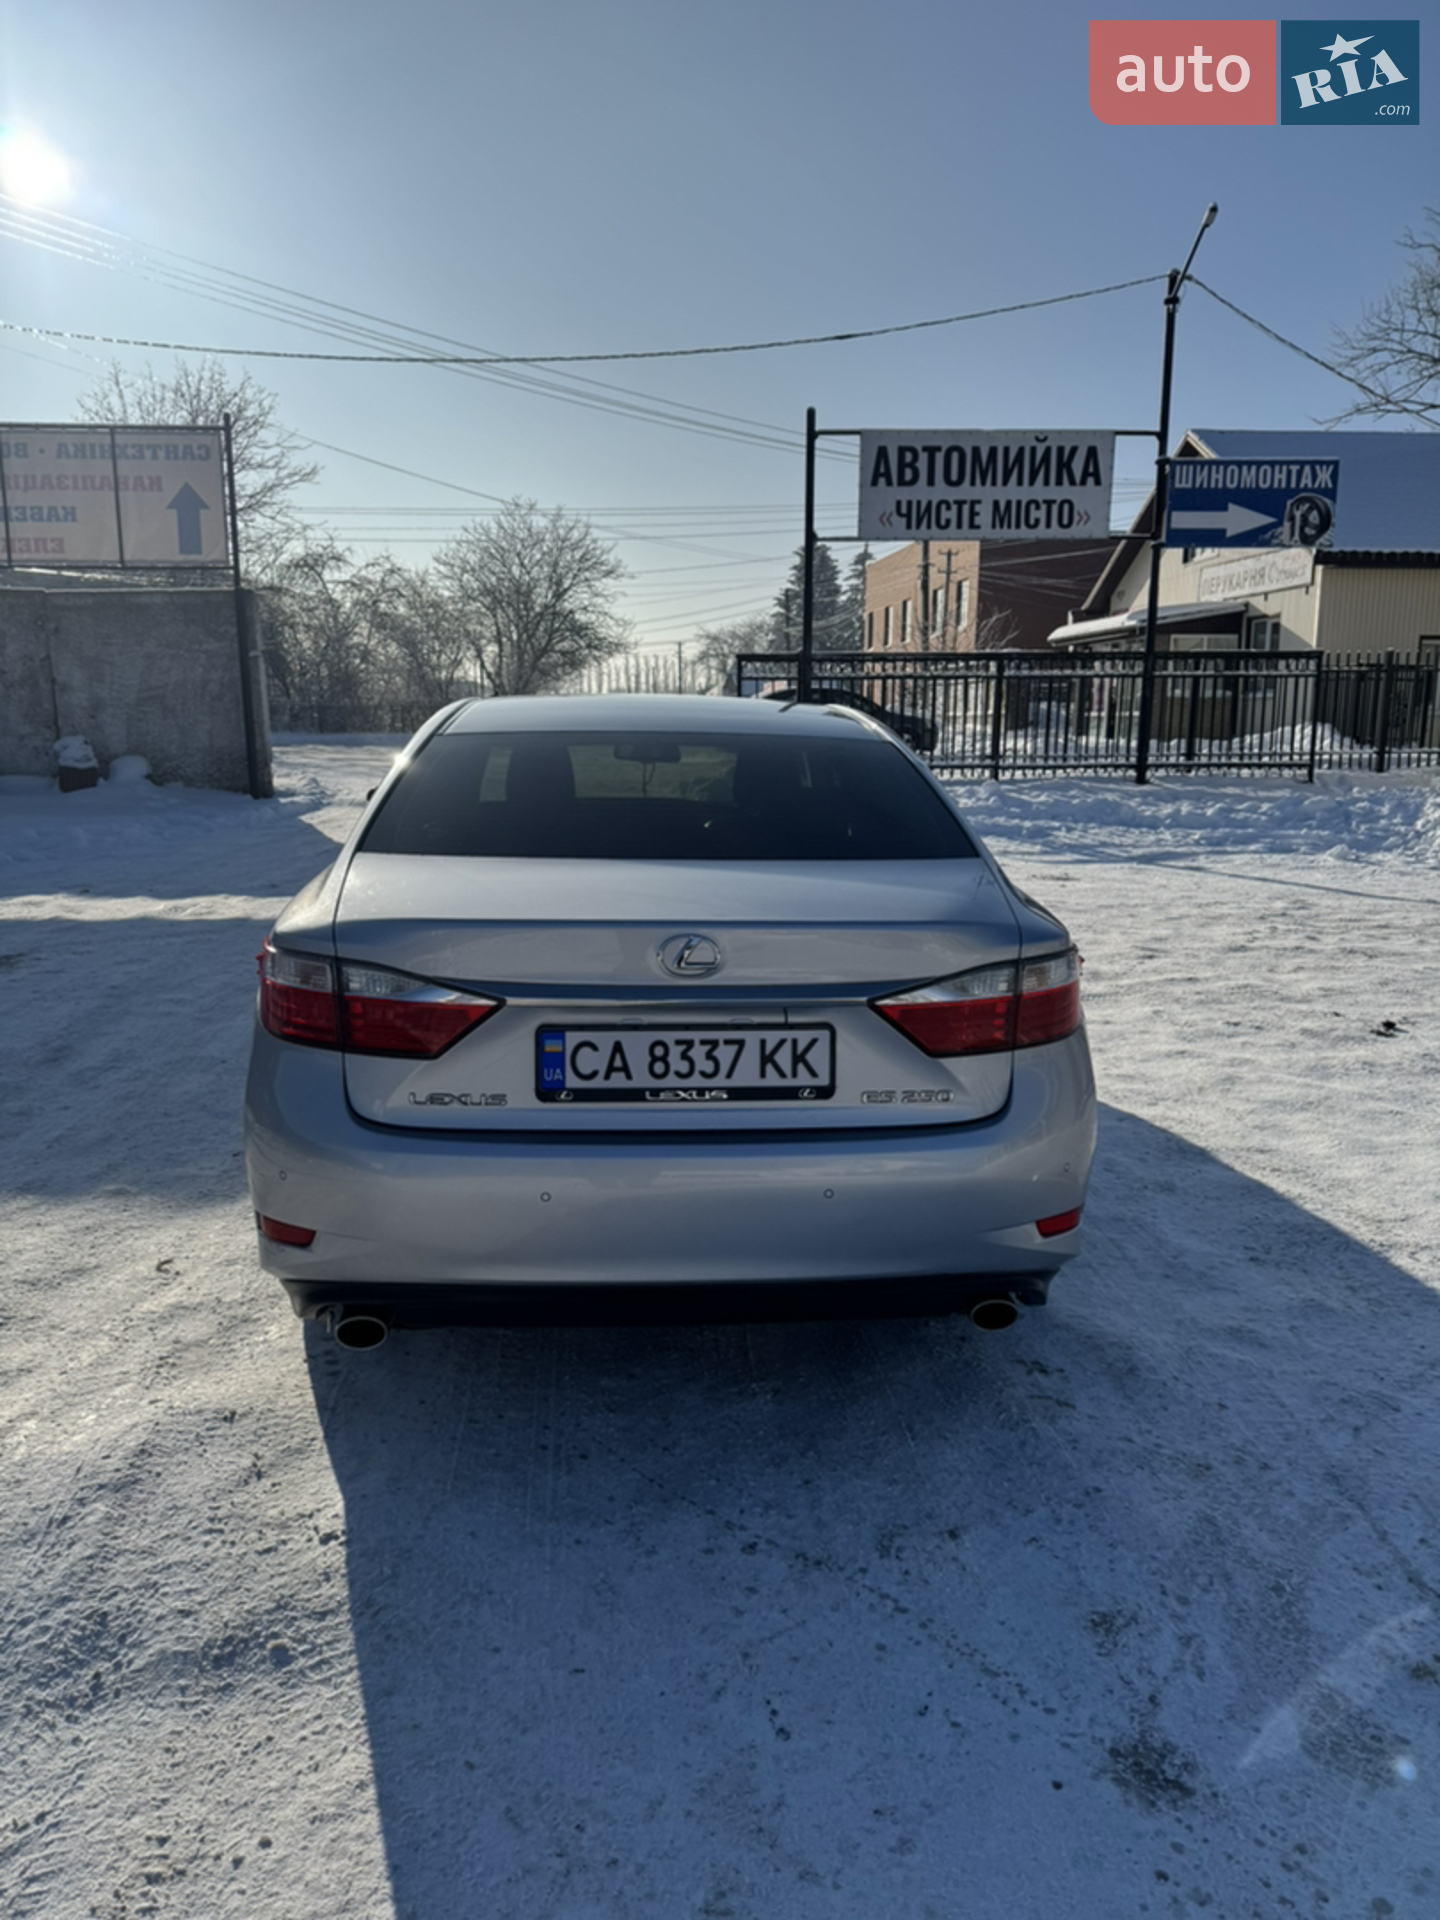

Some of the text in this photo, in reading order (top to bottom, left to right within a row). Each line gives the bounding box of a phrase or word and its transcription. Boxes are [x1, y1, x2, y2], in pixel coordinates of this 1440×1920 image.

[870, 435, 1103, 487] АВТОМИЙКА
[1174, 464, 1334, 489] ШИНОМОНТАЖ
[878, 498, 1092, 530] «ЧИСТЕ МІСТО»
[1202, 566, 1266, 596] ПЕРУКАРНЯ
[569, 1038, 819, 1081] CA 8337 KK
[543, 1068, 563, 1081] UA
[408, 1091, 508, 1107] LEXUS
[645, 1090, 728, 1101] LEXUS
[861, 1089, 898, 1105] ES
